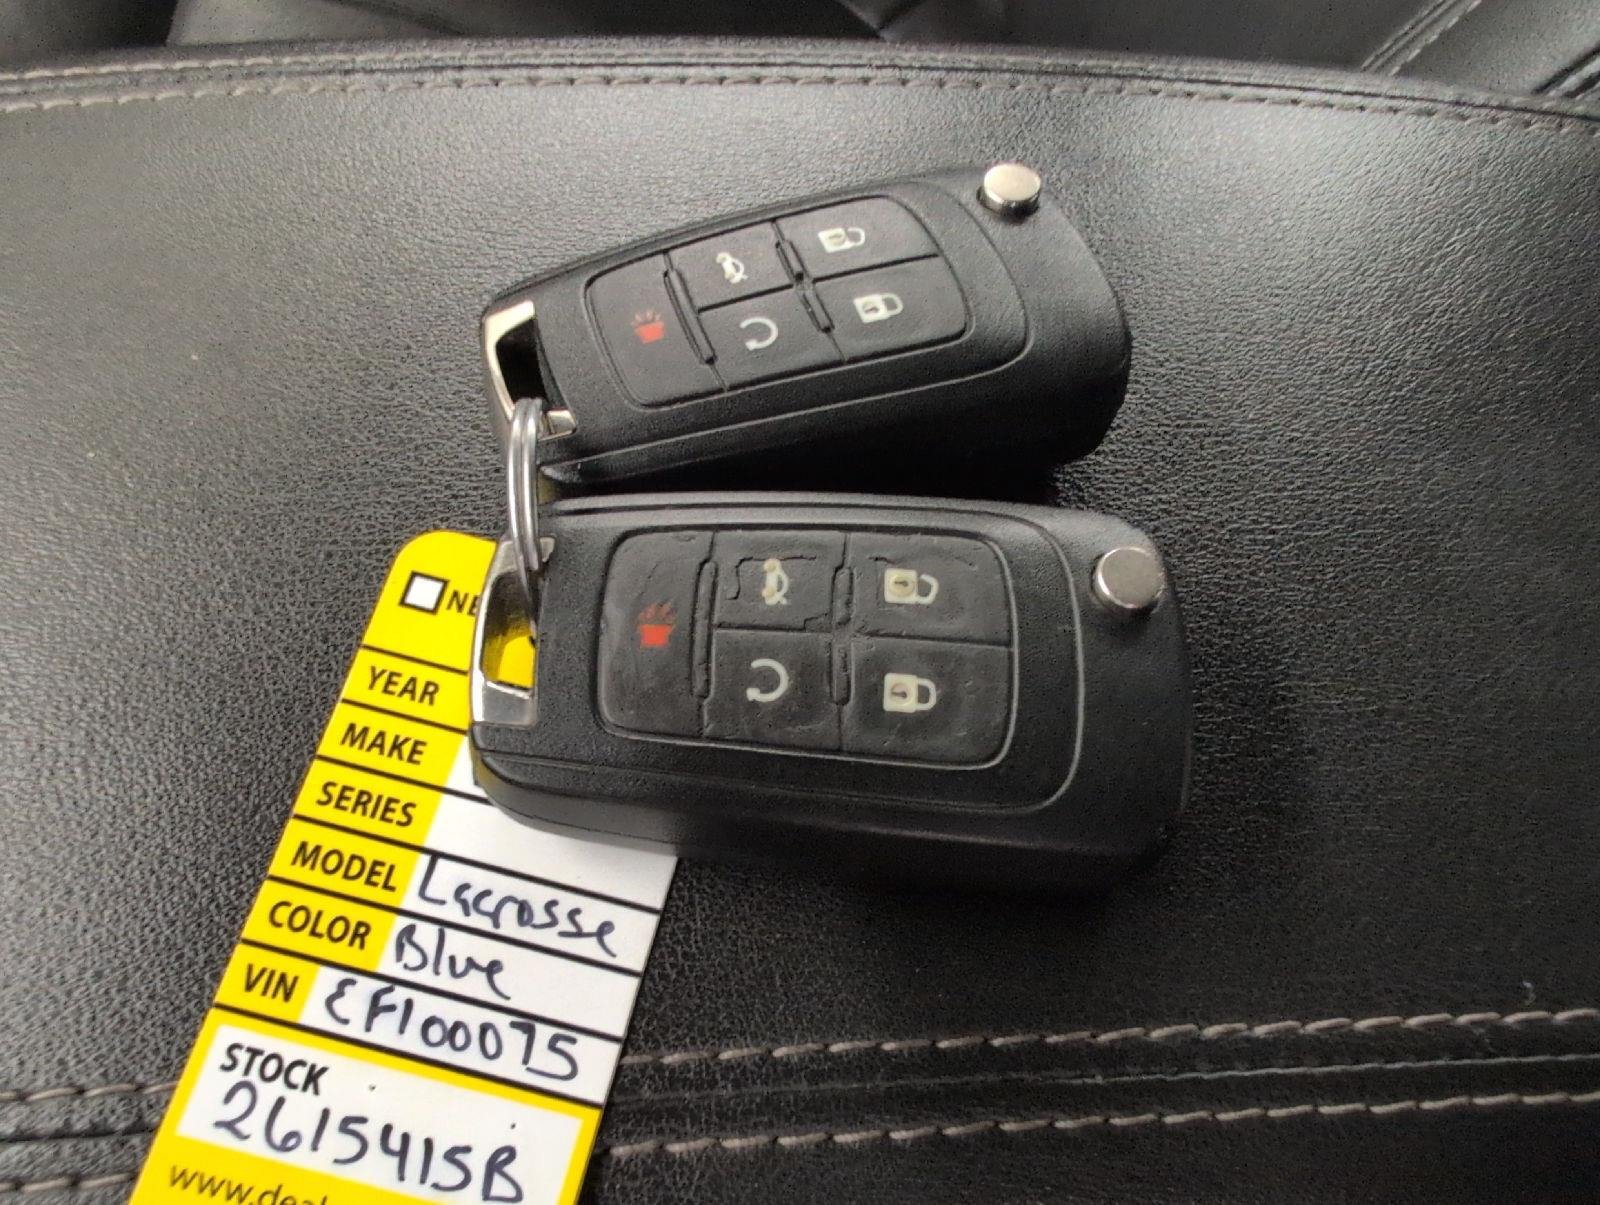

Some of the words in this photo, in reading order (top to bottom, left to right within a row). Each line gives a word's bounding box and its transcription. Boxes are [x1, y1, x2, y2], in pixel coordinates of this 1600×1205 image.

[367, 665, 440, 706] YEAR
[341, 722, 428, 766] MAKE
[316, 780, 417, 828] SERIES
[291, 840, 397, 892] MODEL
[268, 900, 372, 951] COLOR
[242, 962, 299, 1003] VIN
[394, 923, 511, 1001] Blue
[219, 1042, 330, 1096] STOCK
